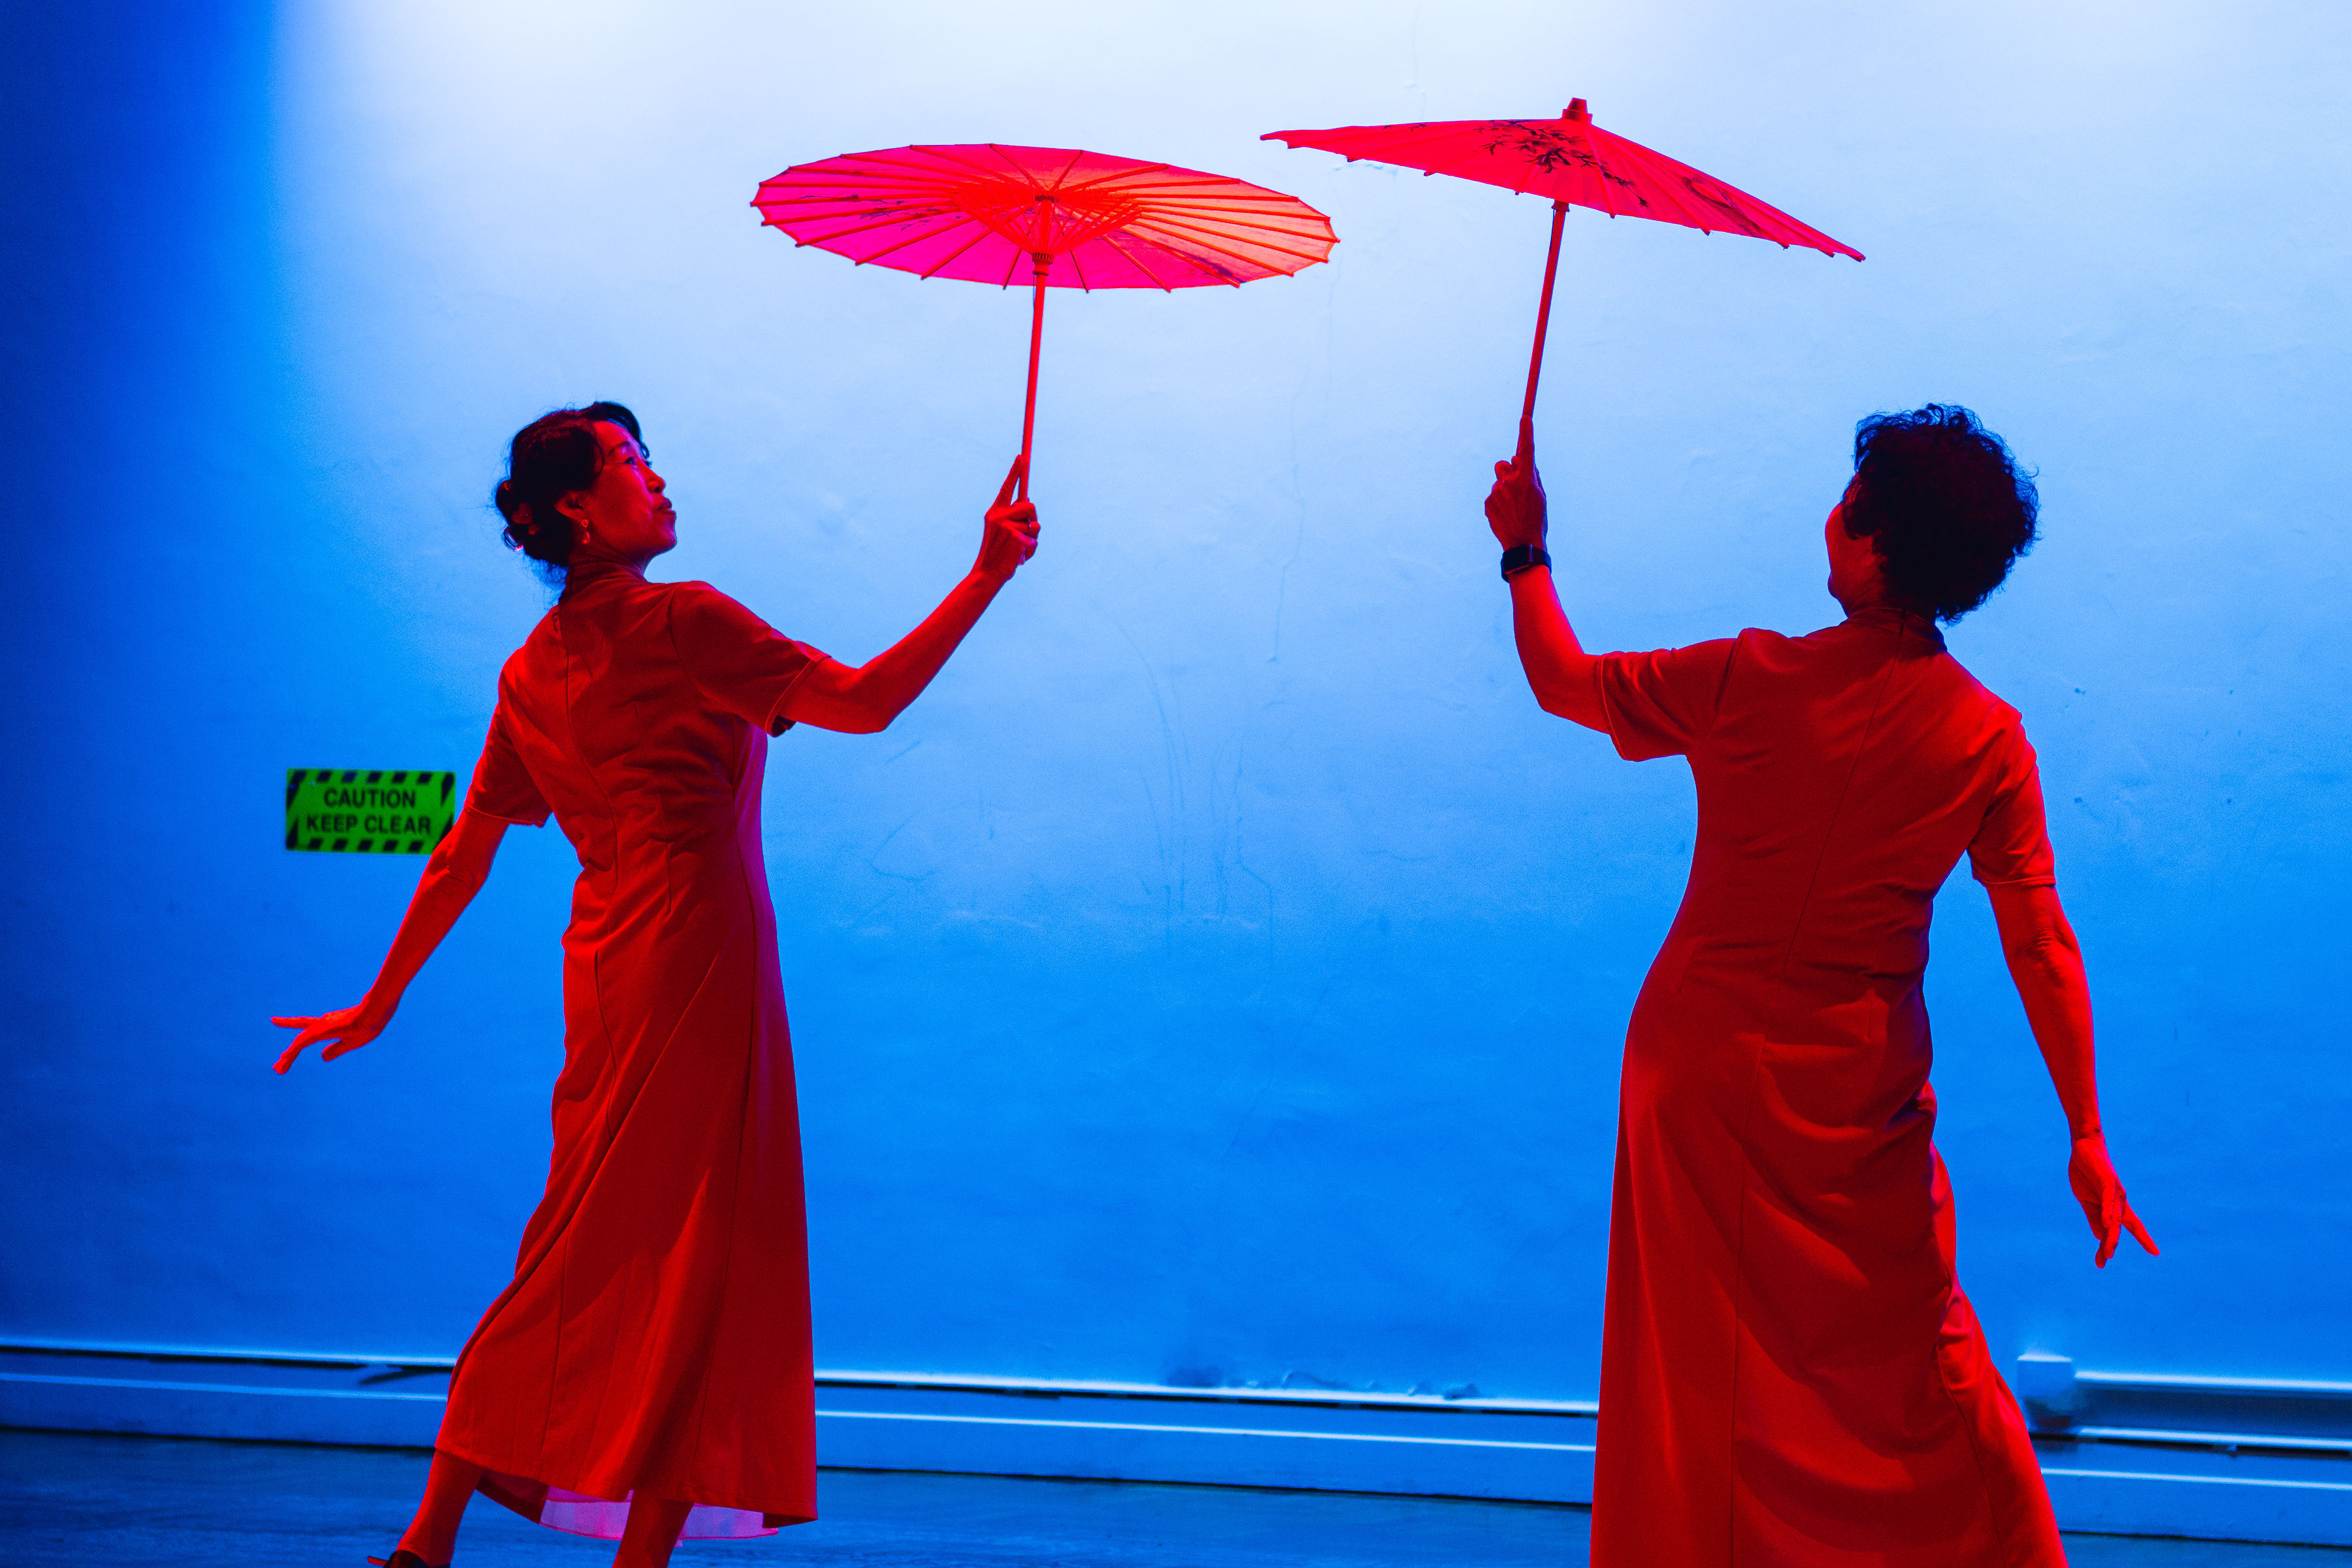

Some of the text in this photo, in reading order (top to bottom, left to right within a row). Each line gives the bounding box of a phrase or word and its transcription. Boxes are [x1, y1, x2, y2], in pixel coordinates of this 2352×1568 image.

[324, 789, 415, 808] CAUTION
[307, 814, 431, 834] KEEP CLEAR
